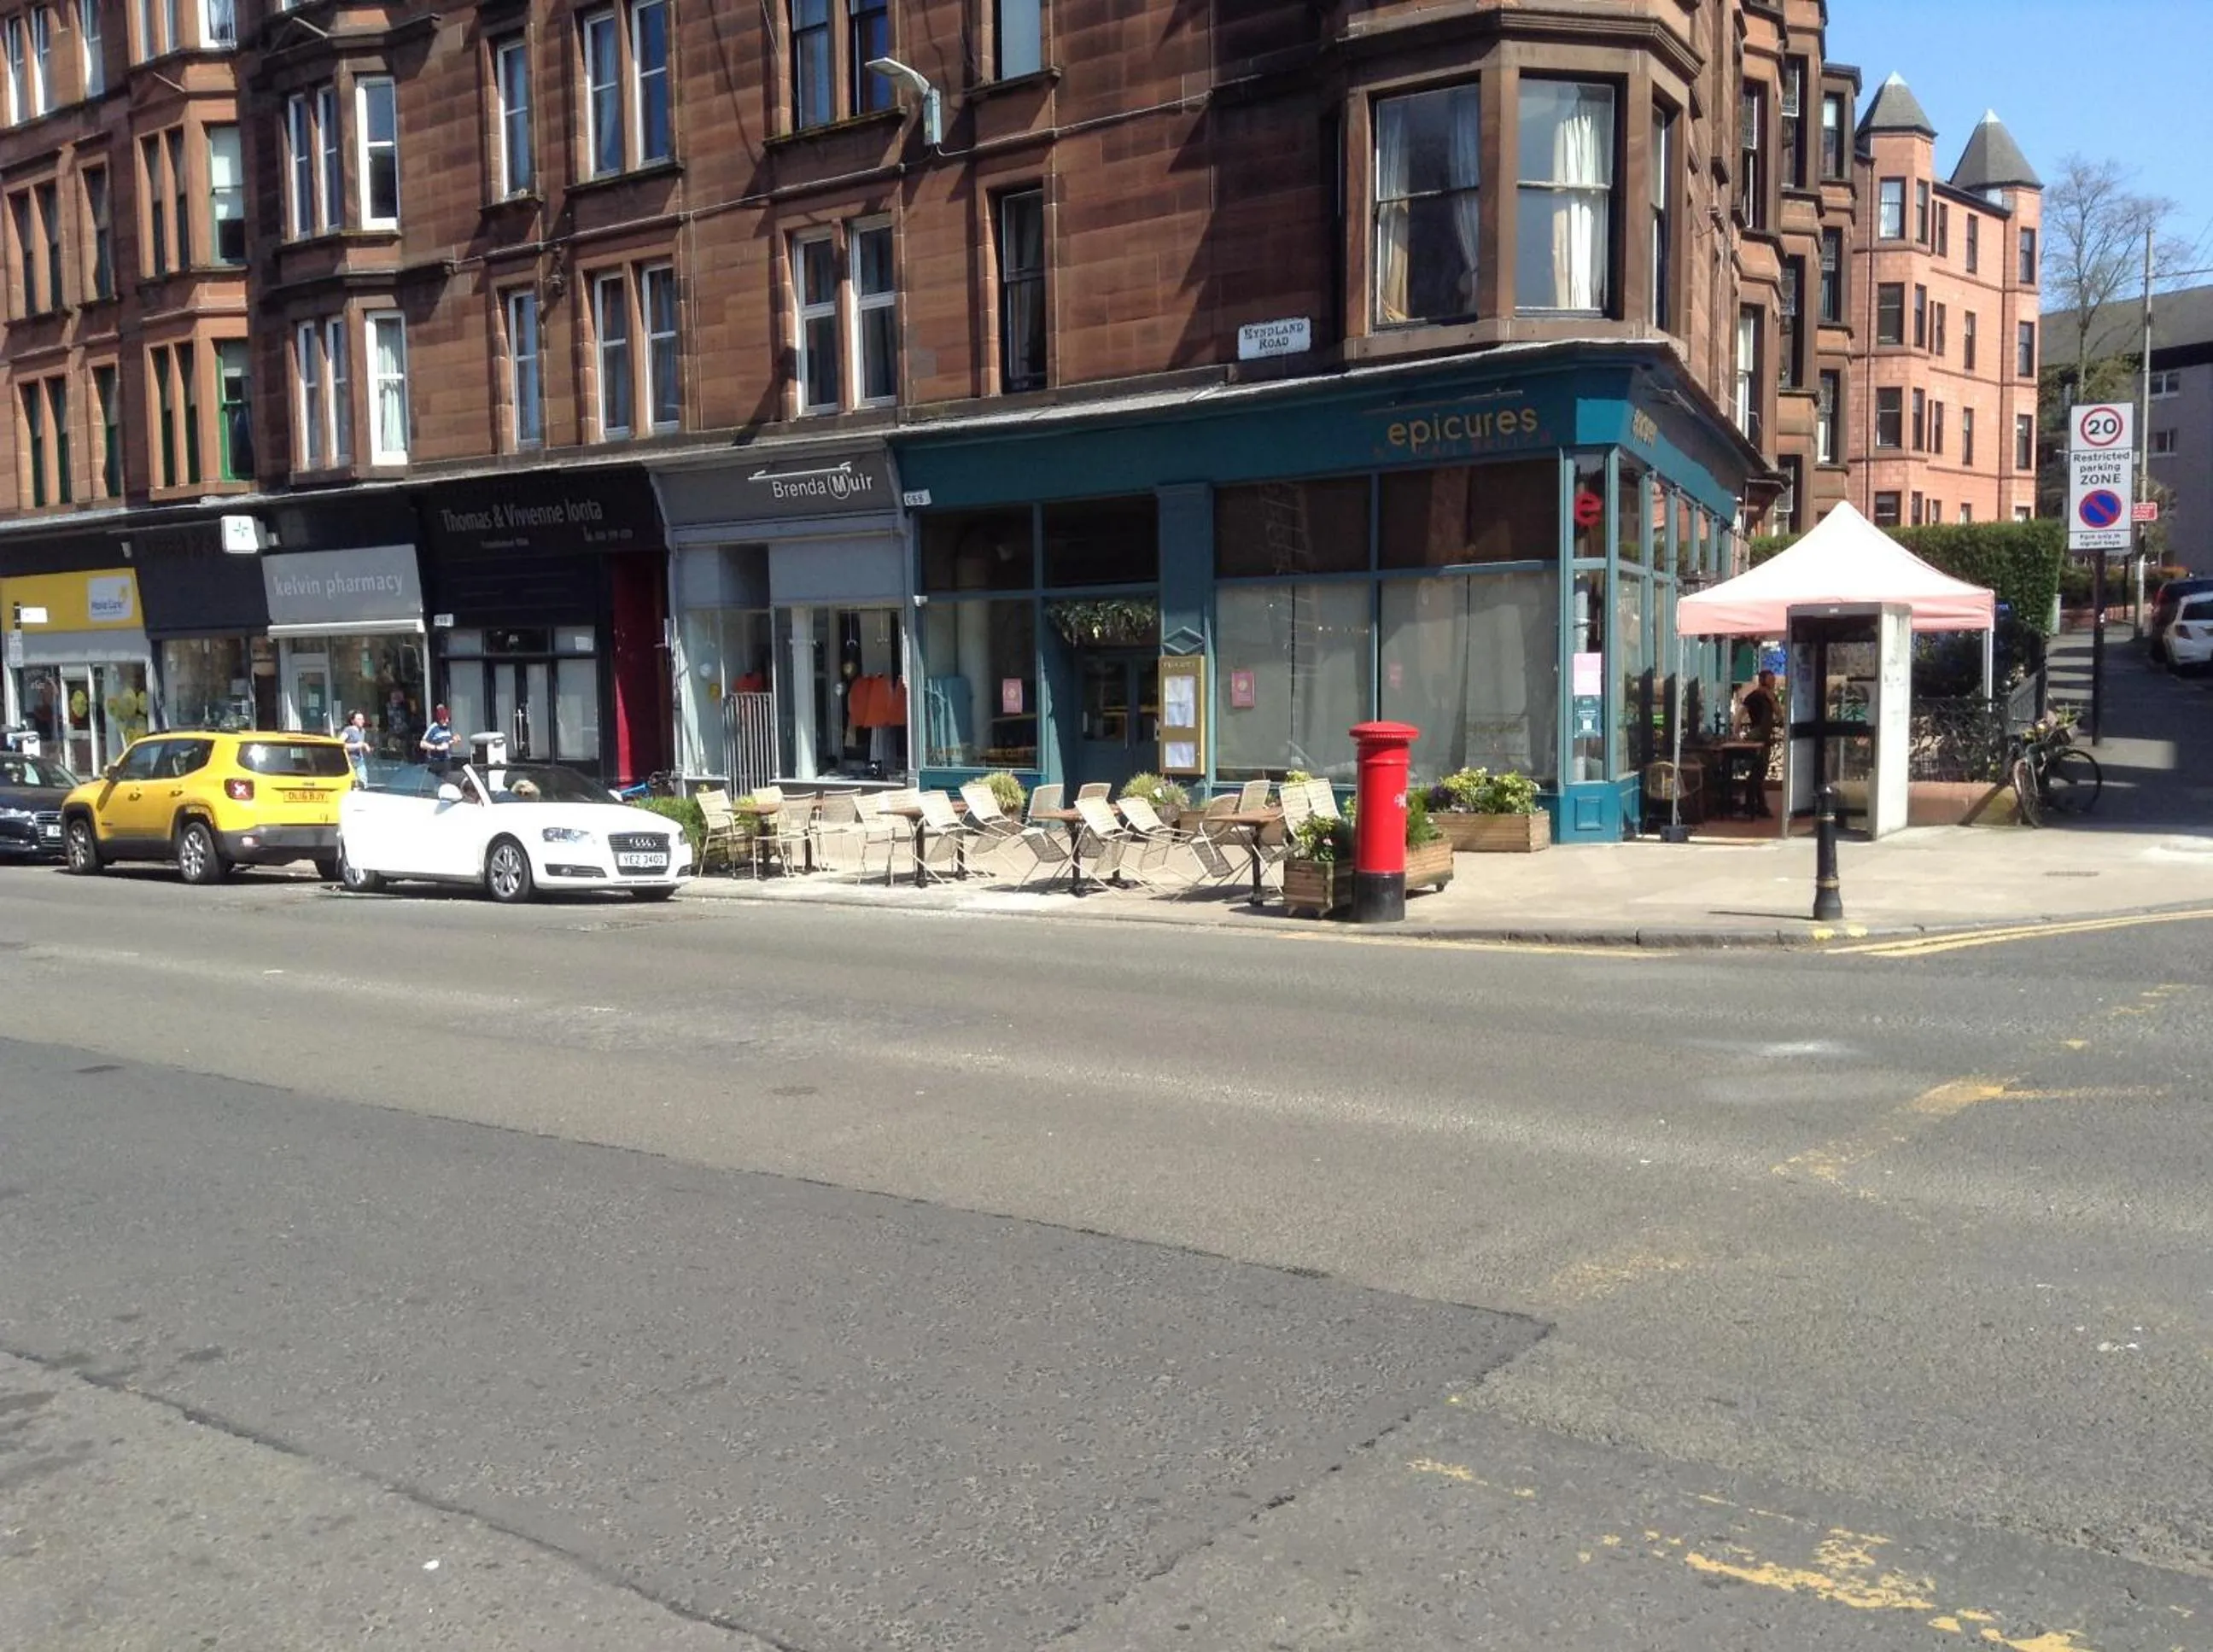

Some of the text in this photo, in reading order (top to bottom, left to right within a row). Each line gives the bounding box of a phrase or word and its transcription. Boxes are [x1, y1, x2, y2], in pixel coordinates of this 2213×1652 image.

[1259, 336, 1288, 350] ROAD
[1387, 407, 1538, 452] epicures
[2088, 418, 2117, 435] 20
[2074, 452, 2130, 463] Restricted
[2080, 463, 2121, 473] parking
[773, 473, 873, 498] Brenda Muir
[2081, 474, 2121, 485] ZONE
[441, 509, 492, 532] Thomas
[493, 504, 504, 528] &
[273, 571, 402, 599] kelvin pharmacy
